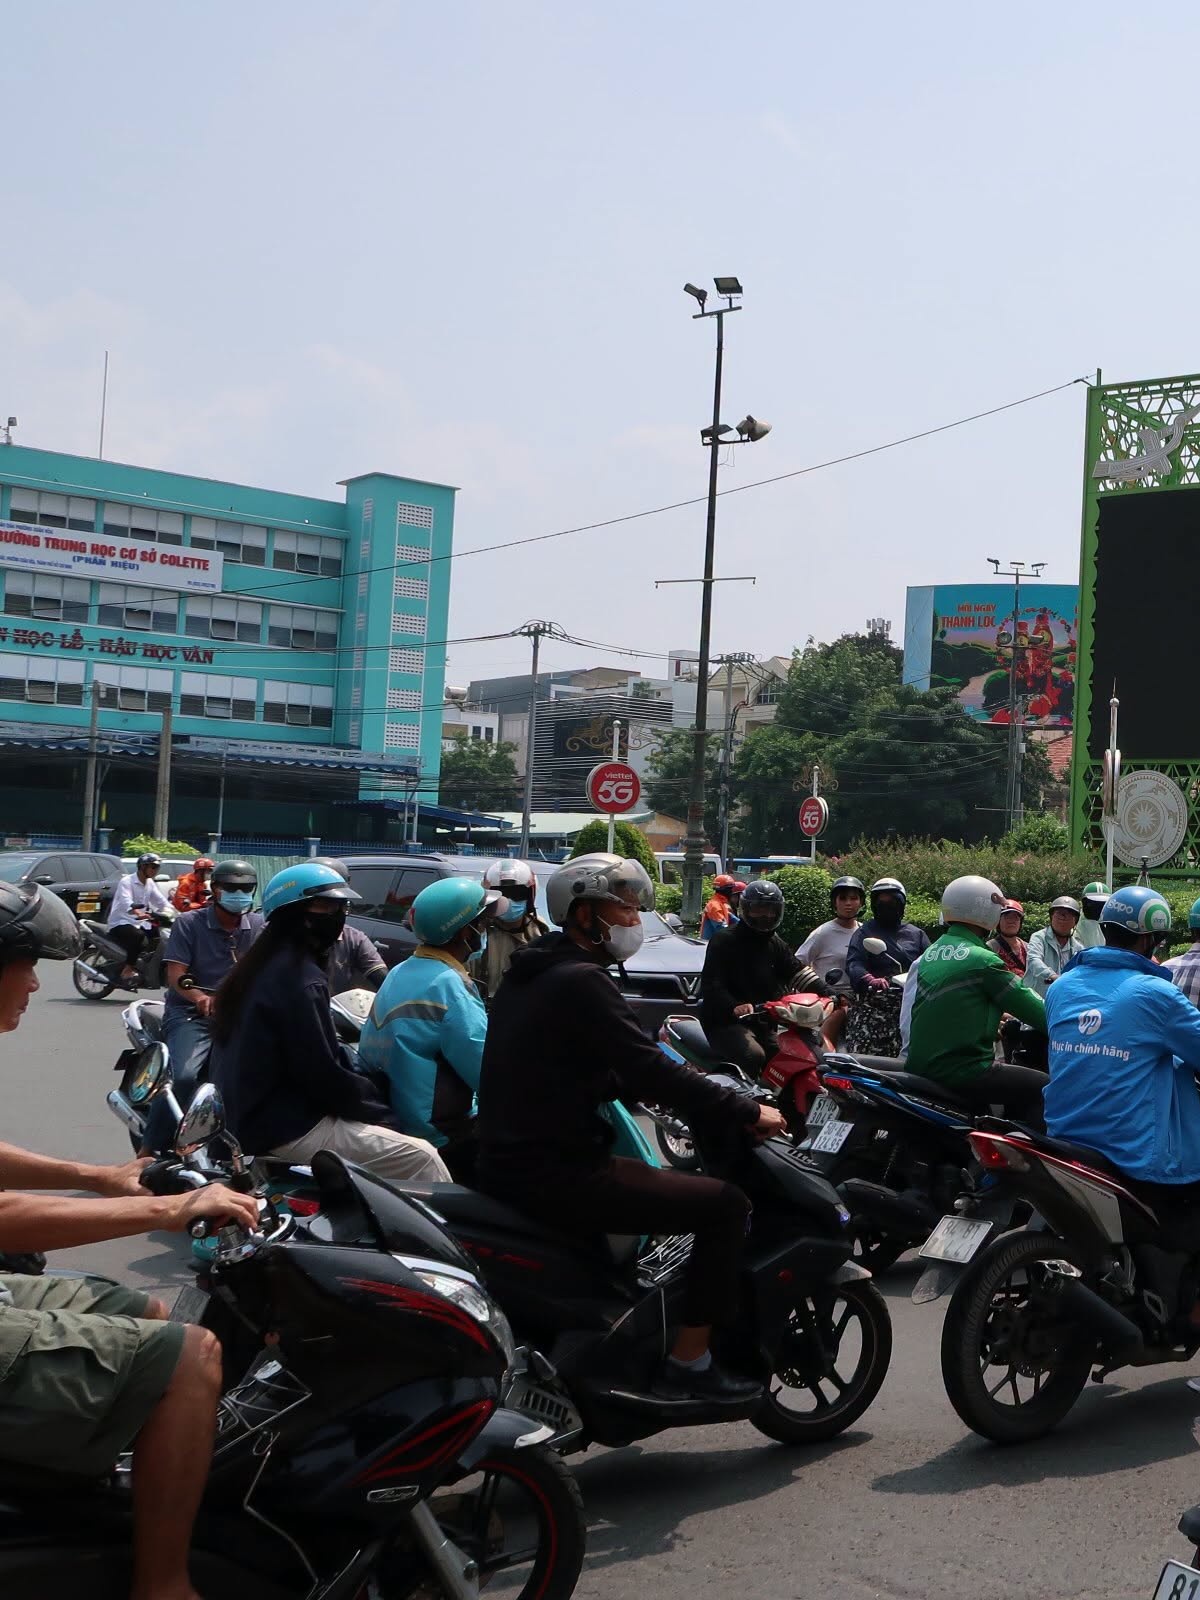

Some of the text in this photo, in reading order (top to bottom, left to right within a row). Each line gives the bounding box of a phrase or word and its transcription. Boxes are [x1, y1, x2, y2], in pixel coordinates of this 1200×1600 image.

[44, 536, 87, 553] TRUNG
[91, 543, 116, 558] HỌC
[120, 547, 138, 560] CƠ
[140, 547, 157, 563] SỞ
[160, 553, 210, 571] COLETTE
[941, 616, 975, 628] THANH
[13, 628, 53, 648] HỌC
[142, 643, 177, 662] HỌC
[598, 780, 634, 804] 5G
[803, 811, 819, 829] 5G
[925, 942, 970, 962] Grab
[1065, 1042, 1073, 1051] in
[1075, 1041, 1100, 1054] chính
[1103, 1045, 1131, 1061] hãng
